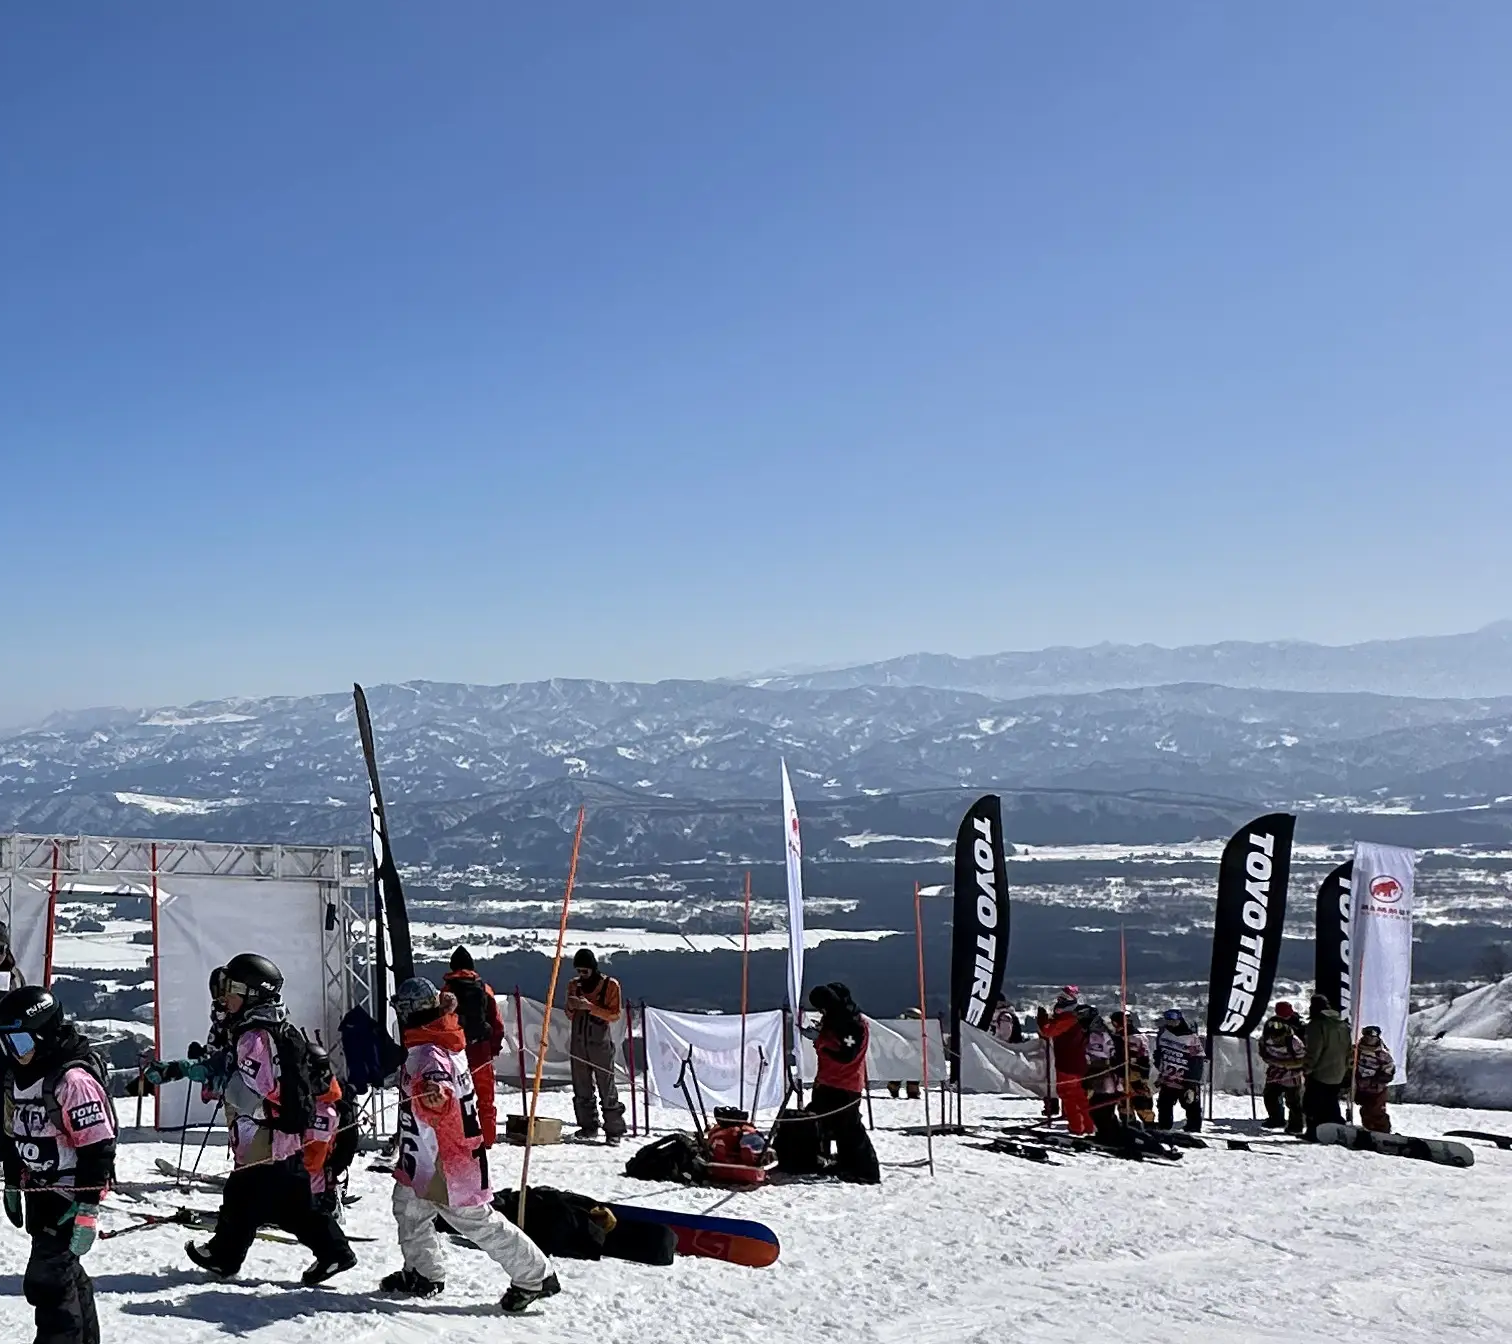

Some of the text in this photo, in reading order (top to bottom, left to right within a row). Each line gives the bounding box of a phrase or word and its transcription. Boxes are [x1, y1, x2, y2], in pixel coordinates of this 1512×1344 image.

[973, 817, 998, 929] TOYO
[1219, 832, 1275, 1033] TOYO TIRES
